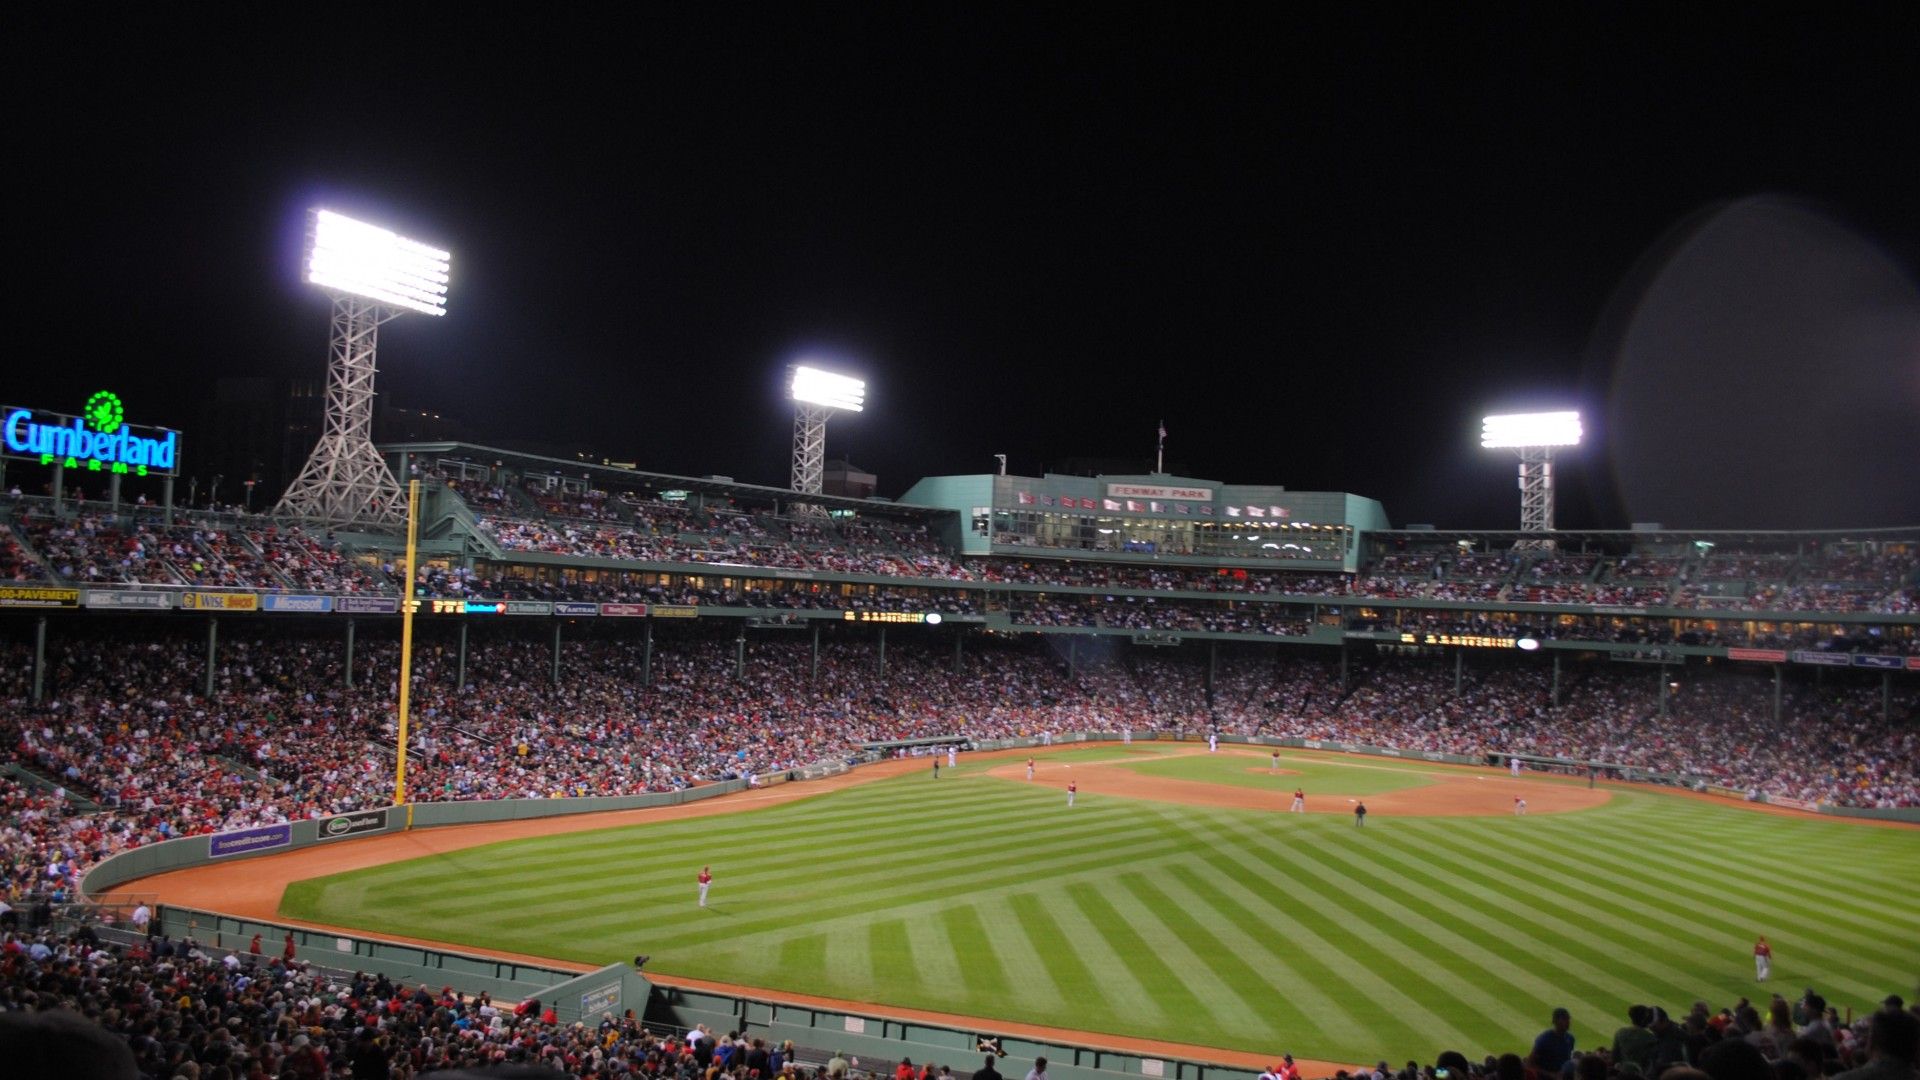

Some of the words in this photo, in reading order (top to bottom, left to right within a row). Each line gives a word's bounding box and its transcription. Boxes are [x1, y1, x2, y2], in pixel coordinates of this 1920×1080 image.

[5, 410, 176, 469] Cumberland
[41, 453, 148, 476] FARMS
[1115, 486, 1164, 496] FENWAY
[1172, 489, 1205, 498] PARK
[274, 597, 323, 610] Microsoft
